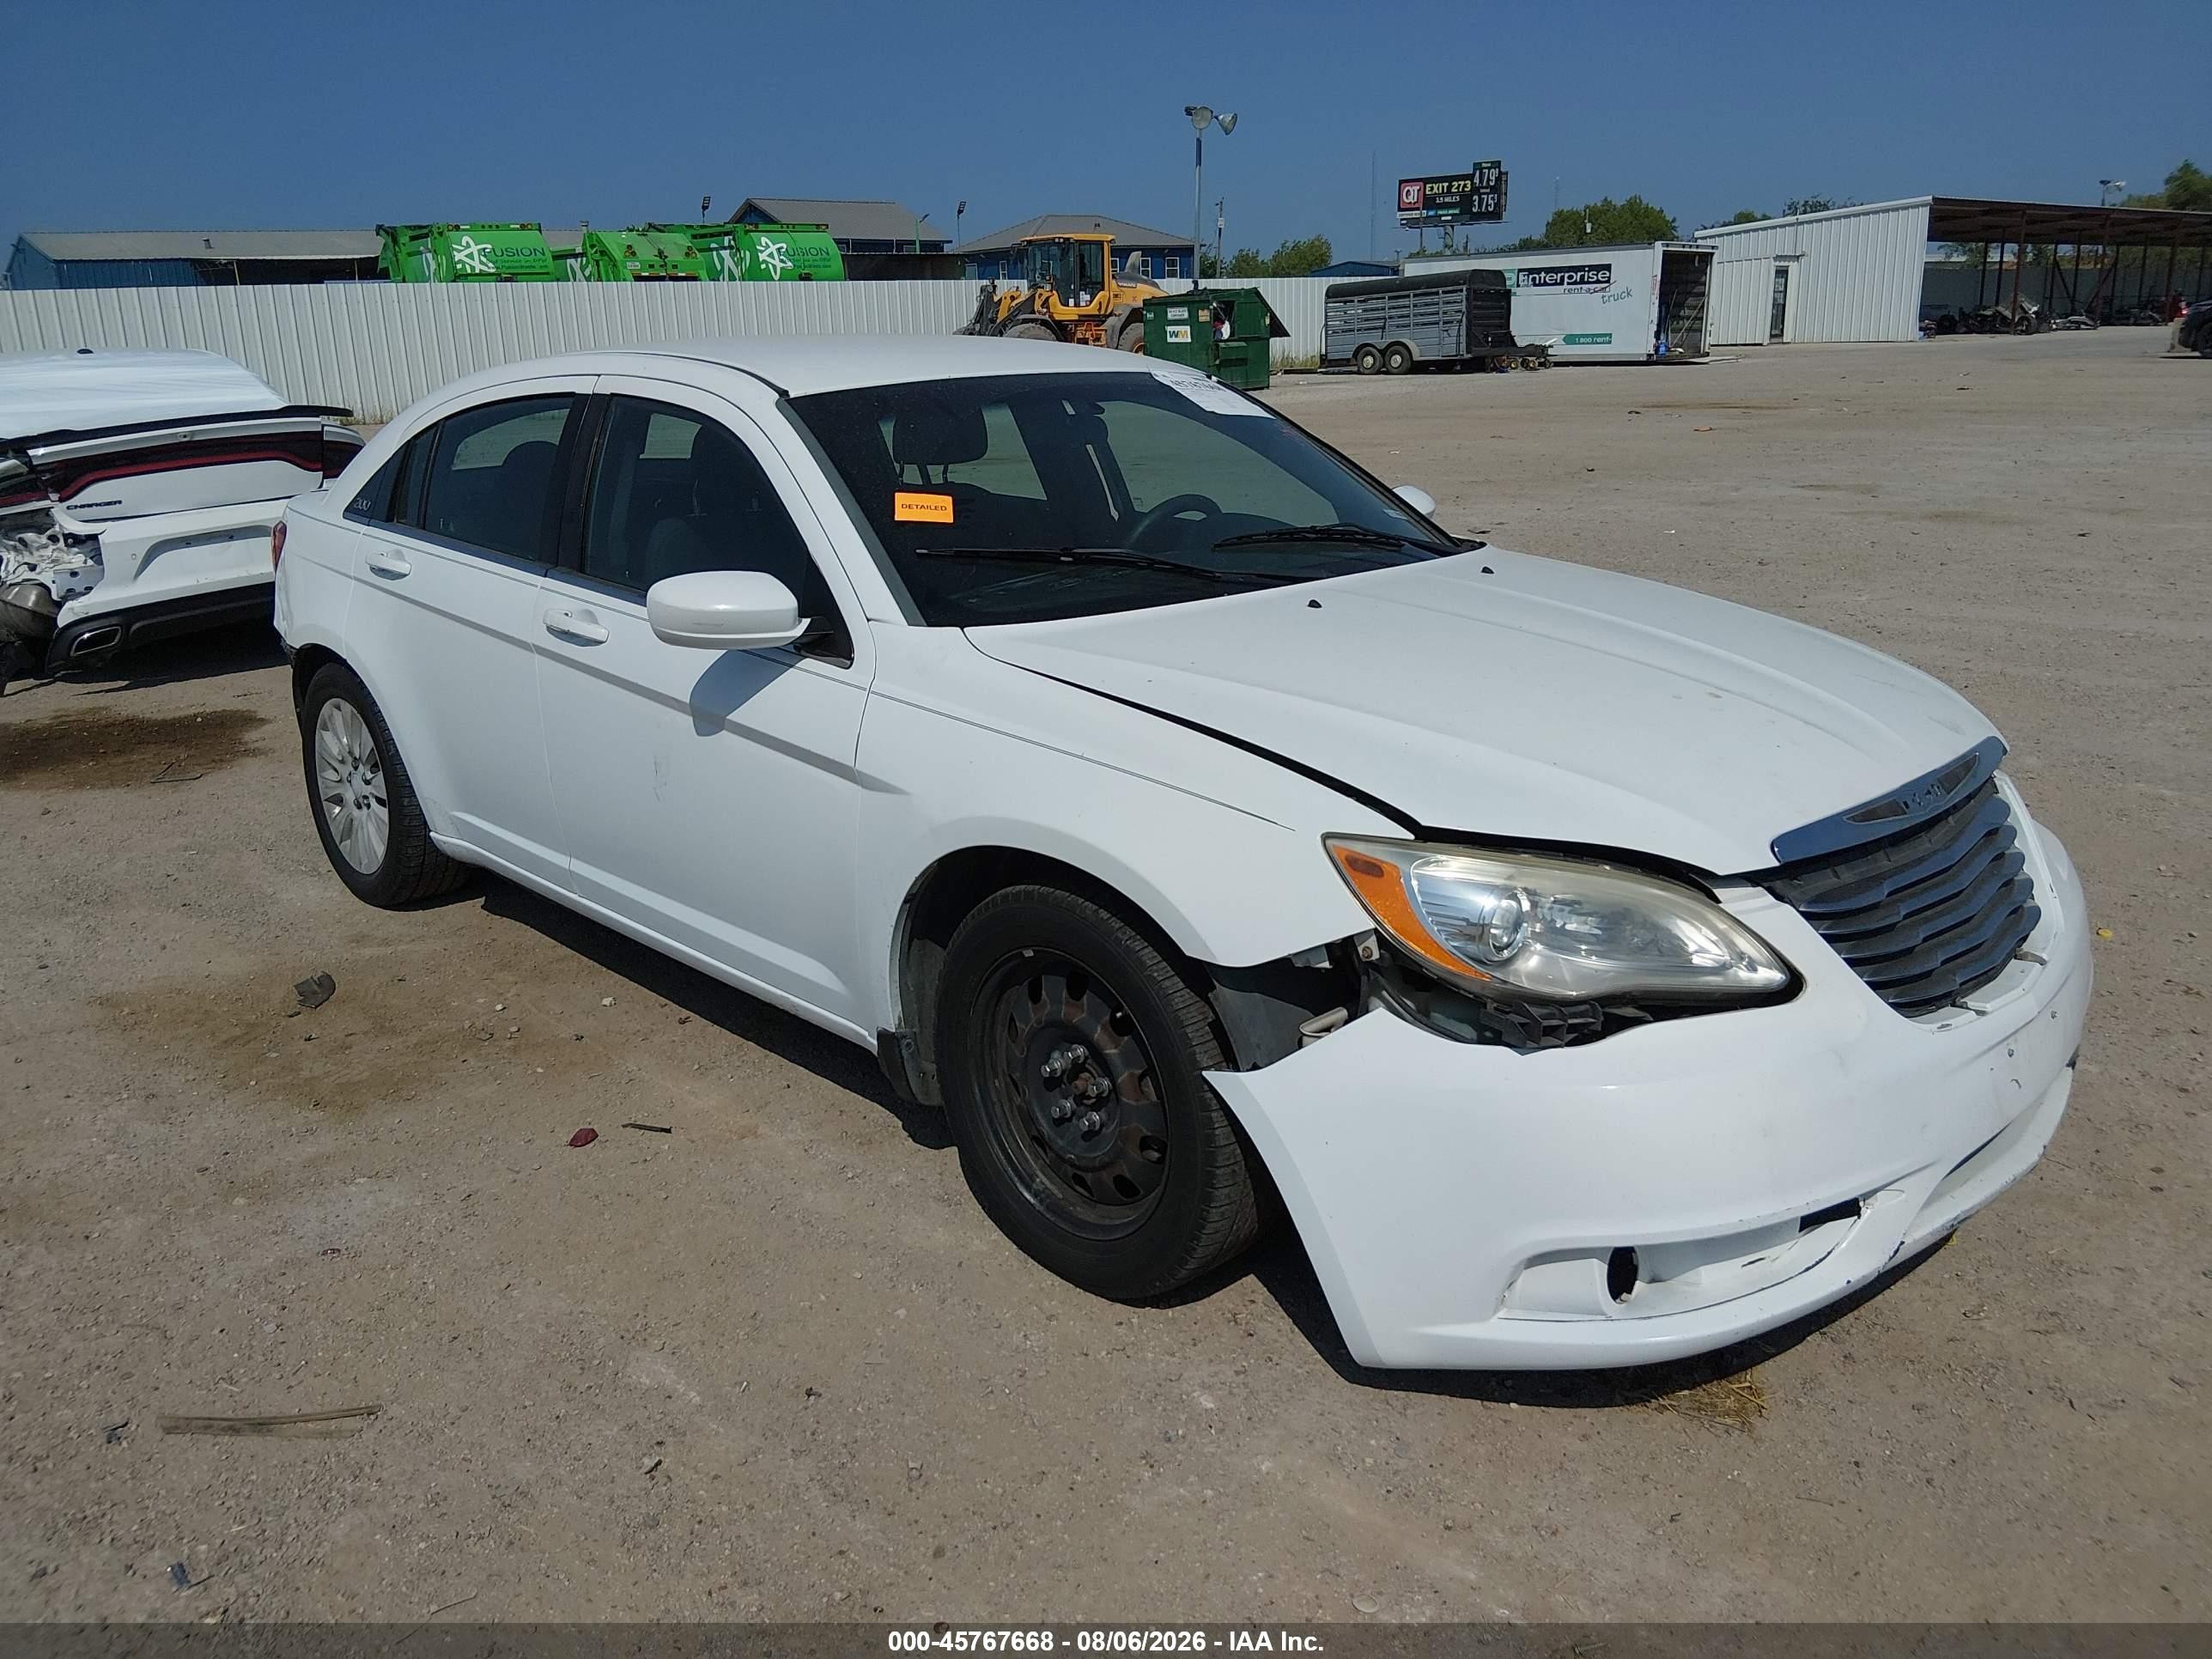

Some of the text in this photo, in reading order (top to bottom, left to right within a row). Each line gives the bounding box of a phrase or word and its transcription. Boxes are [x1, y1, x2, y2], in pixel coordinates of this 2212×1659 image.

[1425, 179, 1471, 195] EXIT 273
[1402, 185, 1420, 204] QT
[483, 247, 545, 257] FUSION
[779, 246, 830, 257] FUSION
[1518, 268, 1610, 286] Enterprise
[1601, 286, 1633, 304] truck
[1169, 330, 1188, 339] WM
[66, 500, 122, 510] CHARGER
[901, 503, 948, 512] DETAILED
